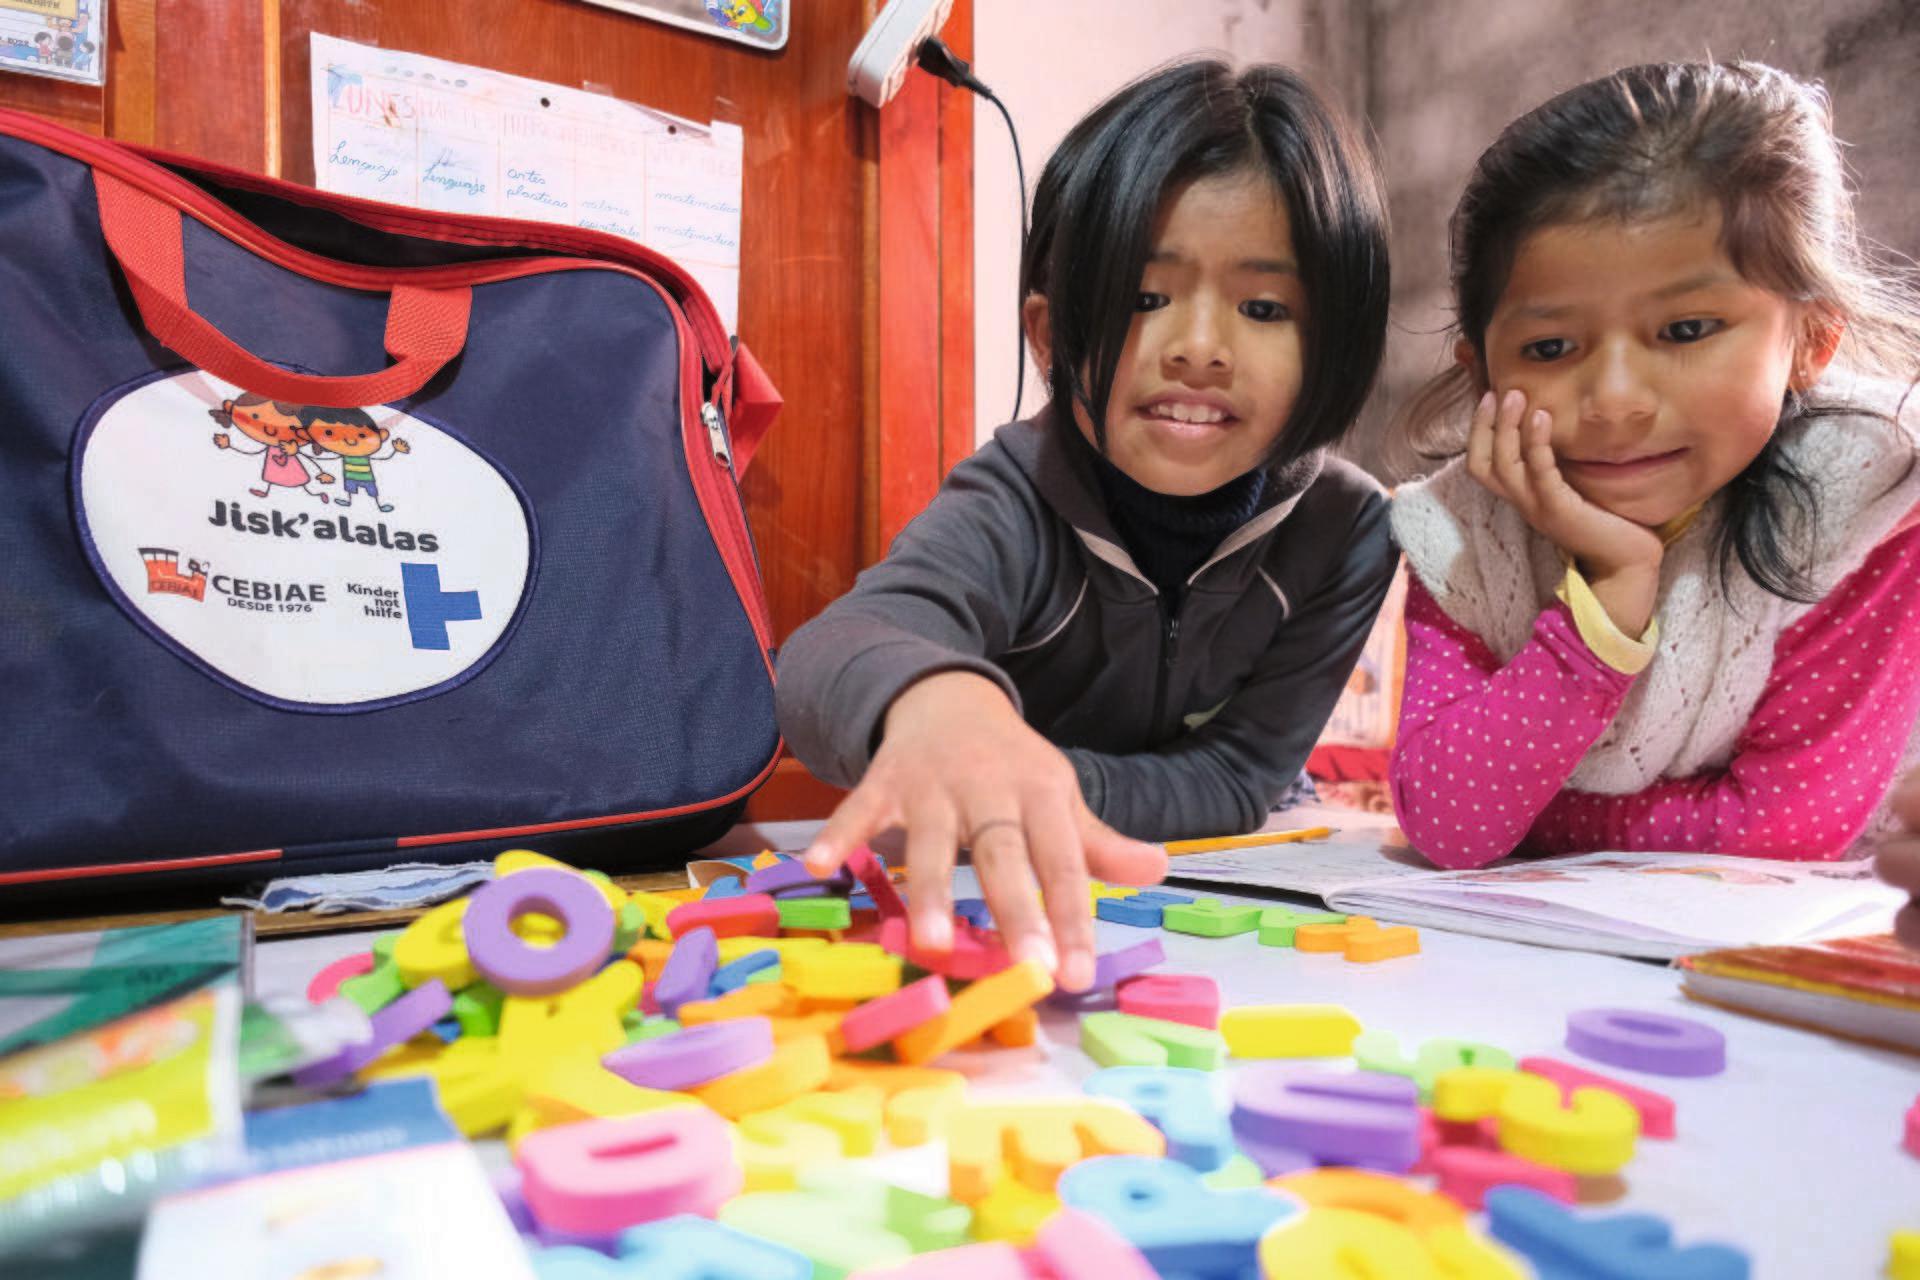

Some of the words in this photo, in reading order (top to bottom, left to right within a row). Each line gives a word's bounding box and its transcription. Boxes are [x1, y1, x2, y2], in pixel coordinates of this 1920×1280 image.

[208, 499, 439, 553] Jisk'alalas
[212, 575, 327, 602] CEBIAE
[346, 583, 399, 598] Kinder
[227, 597, 274, 613] DESDE
[278, 603, 313, 614] 1976
[375, 598, 400, 609] not
[363, 605, 402, 619] hilfe
